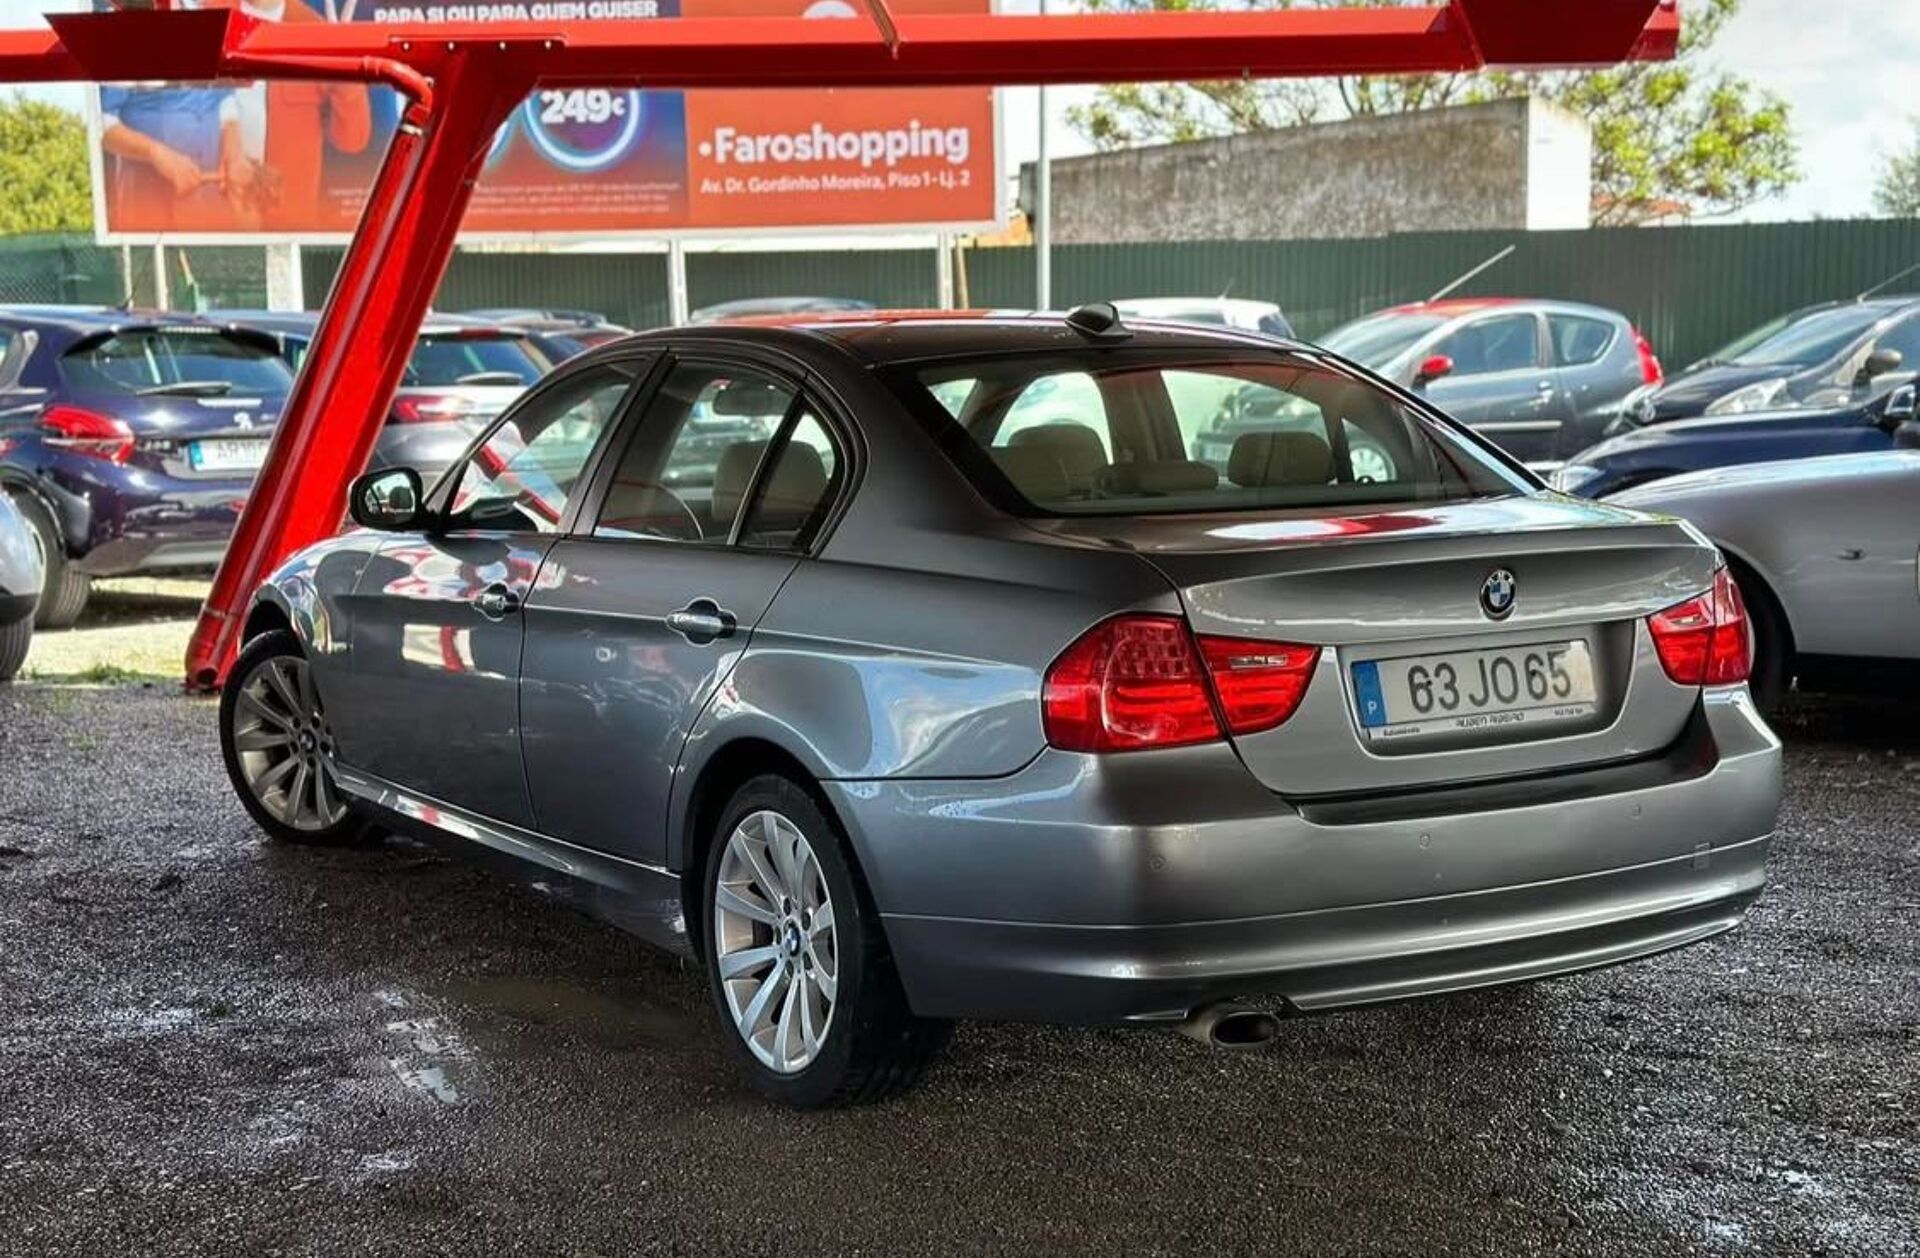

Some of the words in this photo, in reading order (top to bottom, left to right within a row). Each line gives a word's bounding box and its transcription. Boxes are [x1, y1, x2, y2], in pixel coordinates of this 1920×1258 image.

[373, 7, 426, 23] PARA
[427, 6, 445, 22] SI
[447, 5, 475, 21] OU
[477, 4, 530, 21] PARA
[531, 2, 586, 20] QUEM
[588, 1, 659, 19] QUISER
[714, 119, 970, 168] Faroshopping
[701, 178, 722, 194] Av.
[725, 177, 746, 193] Dr.
[748, 174, 820, 193] Gordinho
[822, 171, 886, 191] Moreira,
[888, 171, 921, 188] Piso
[960, 169, 971, 186] 2
[1407, 662, 1461, 714] 63
[1468, 656, 1519, 707] JO
[1523, 650, 1571, 701] 65
[1367, 701, 1378, 716] P
